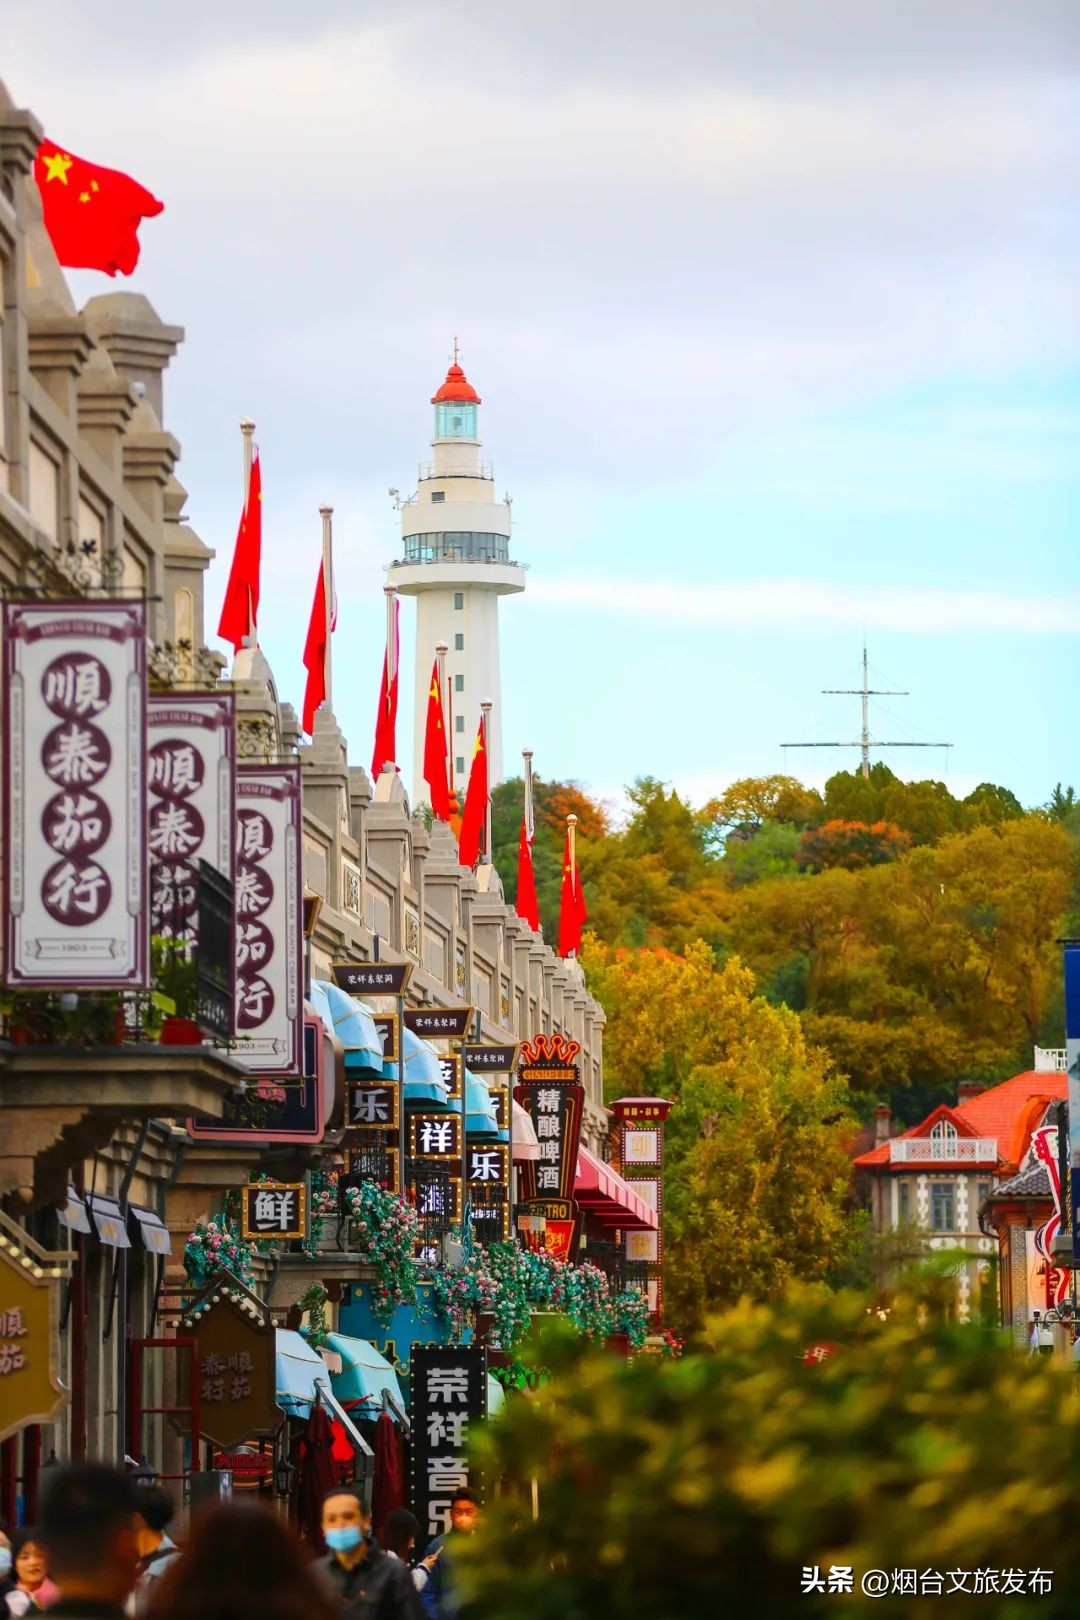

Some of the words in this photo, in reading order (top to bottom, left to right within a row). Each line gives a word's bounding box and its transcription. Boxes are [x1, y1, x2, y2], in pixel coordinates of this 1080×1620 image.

[45, 660, 108, 916] 順泰茄行
[537, 1088, 561, 1189] 精酿啤酒
[254, 1191, 295, 1231] 鲜
